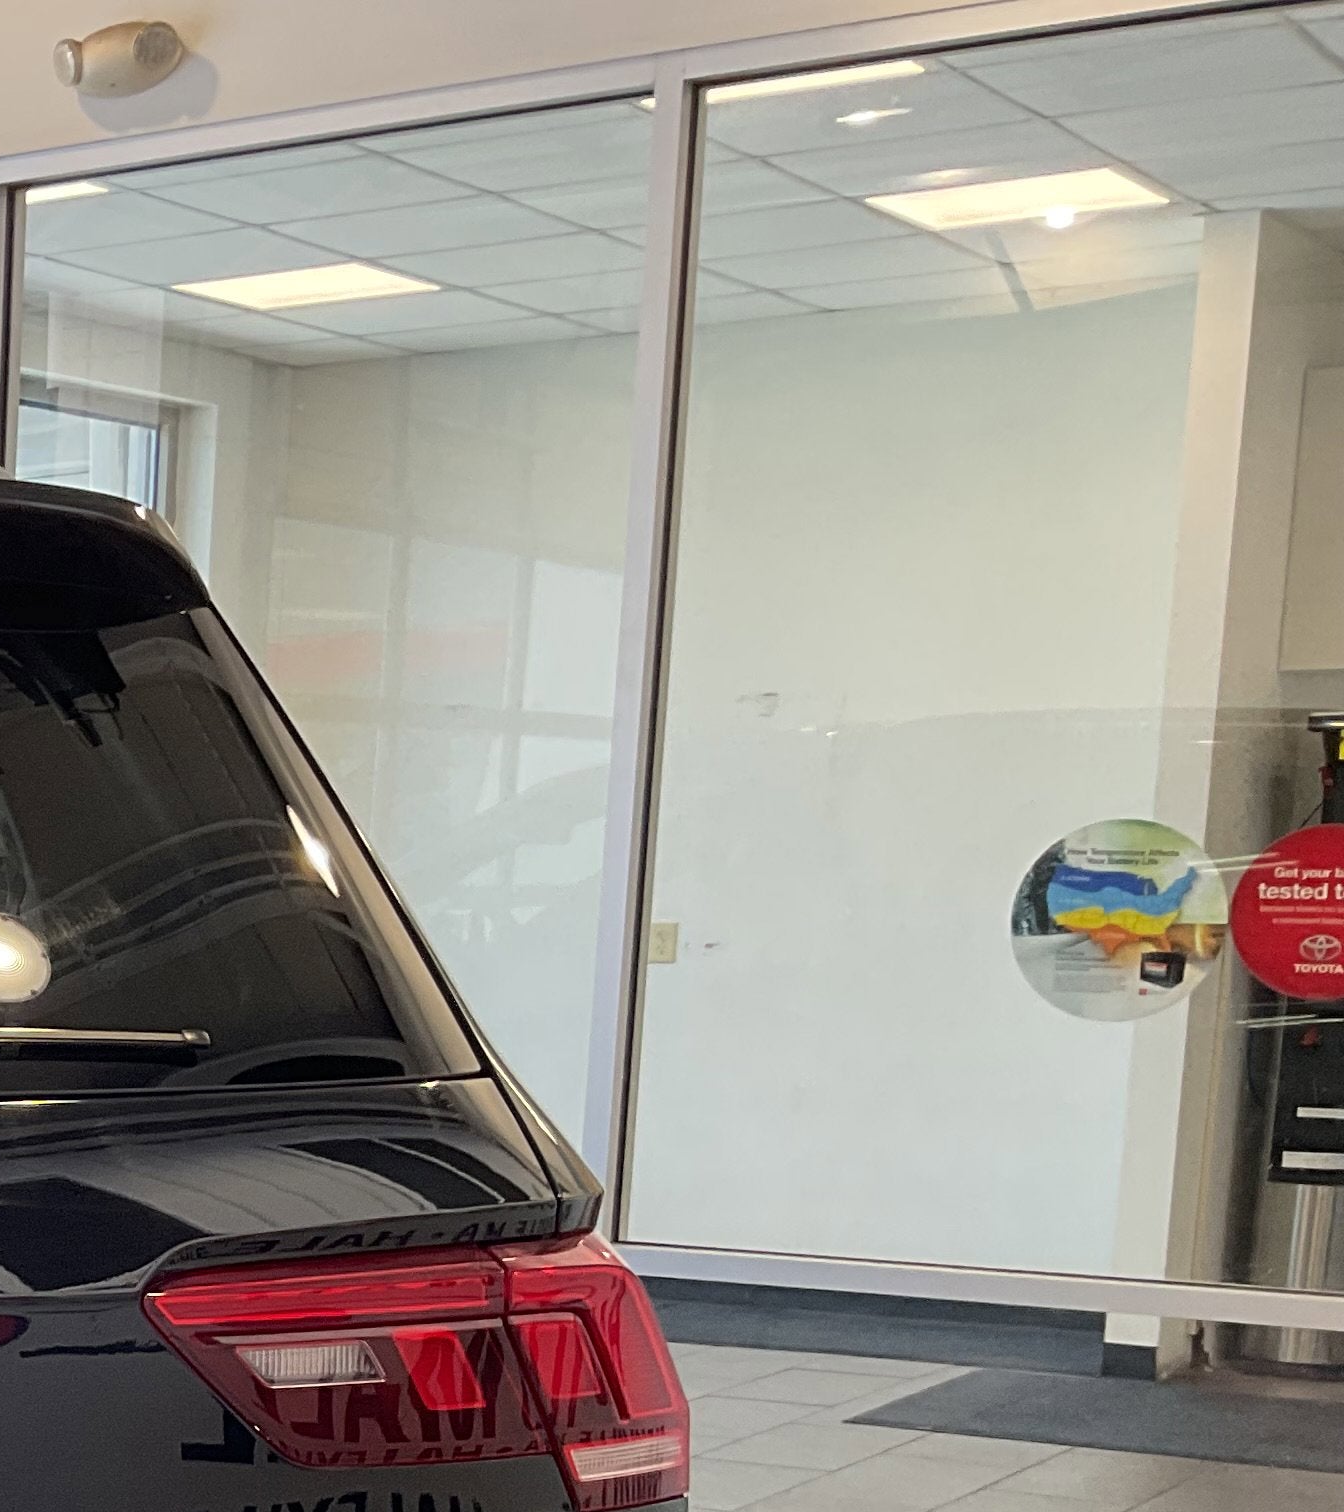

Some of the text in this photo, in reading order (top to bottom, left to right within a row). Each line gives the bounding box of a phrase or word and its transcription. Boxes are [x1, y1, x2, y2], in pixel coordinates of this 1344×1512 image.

[1274, 867, 1298, 878] Get
[1302, 869, 1332, 880] your
[1258, 882, 1329, 900] tested
[1293, 963, 1344, 974] TOYOTA
